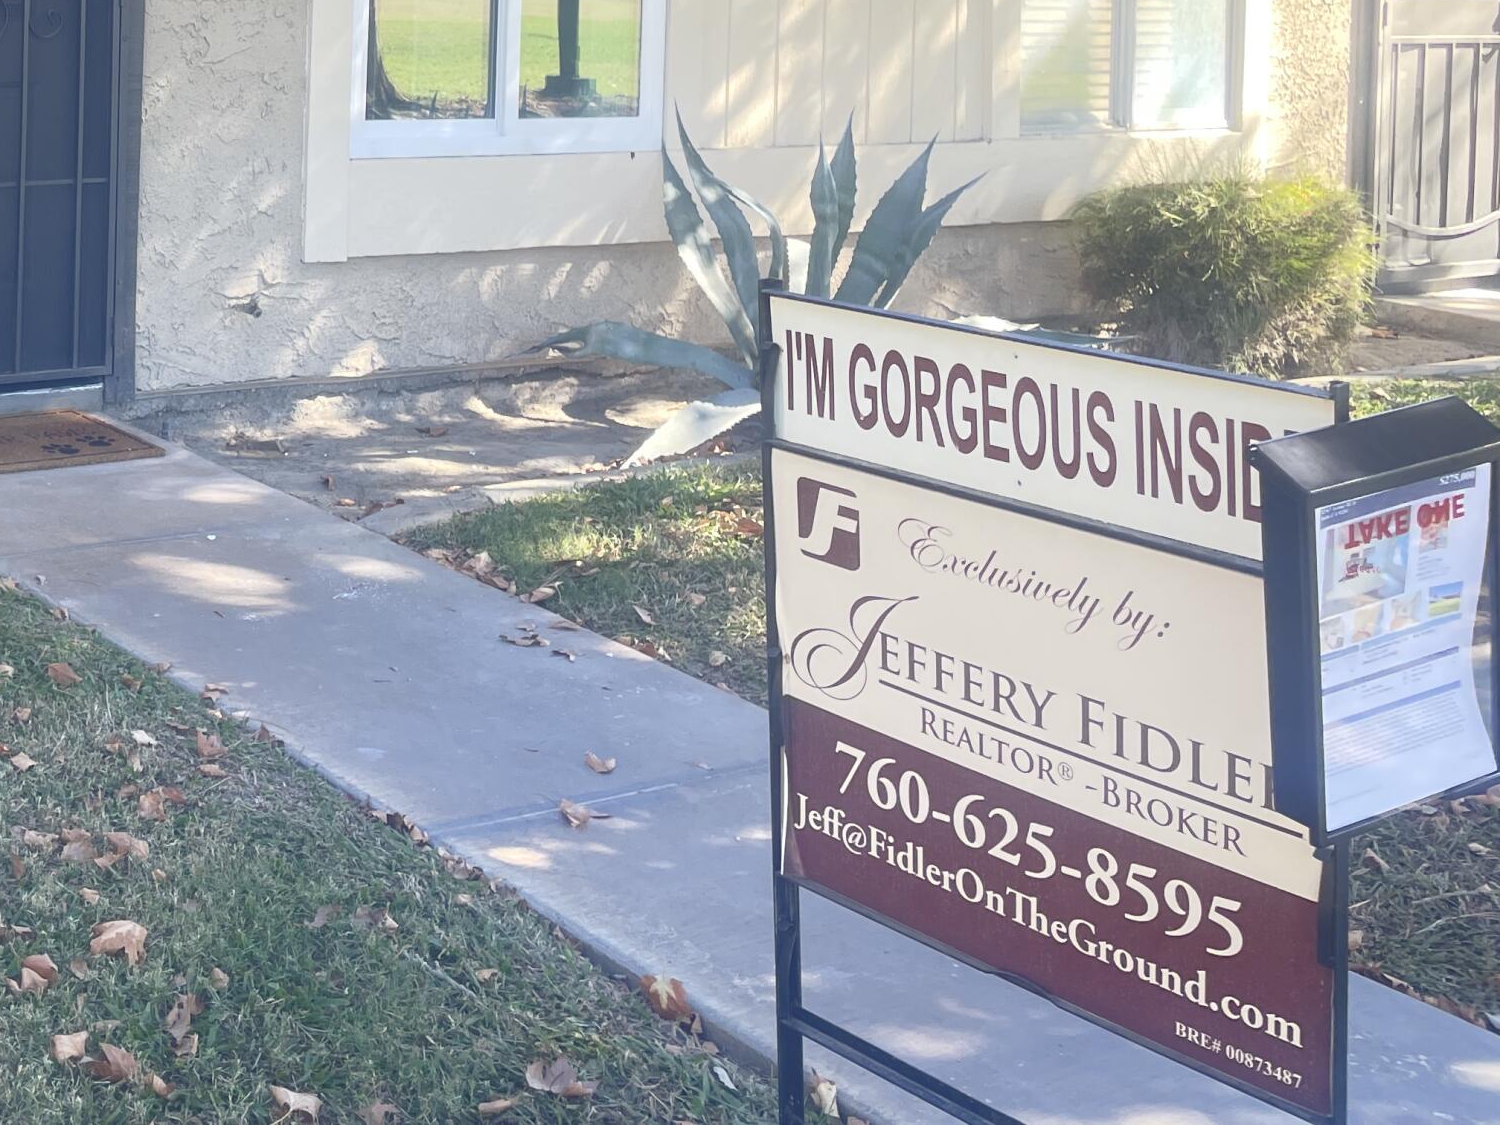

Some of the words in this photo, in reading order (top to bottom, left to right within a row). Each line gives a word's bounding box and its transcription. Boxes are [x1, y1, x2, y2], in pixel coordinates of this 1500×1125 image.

[785, 329, 835, 420] I'M
[849, 342, 1118, 488] GORGEOUS
[1134, 400, 1300, 523] INSID
[790, 594, 1058, 731] JEFFERY
[897, 517, 1104, 635] Exclusively
[1113, 590, 1171, 651] by:
[793, 792, 1304, 1048] Jeff@FidlerOnTheGround.com
[834, 741, 1245, 957] 760-625-8595
[1175, 1021, 1222, 1055] BRE#
[1225, 1044, 1303, 1089] 00873487
